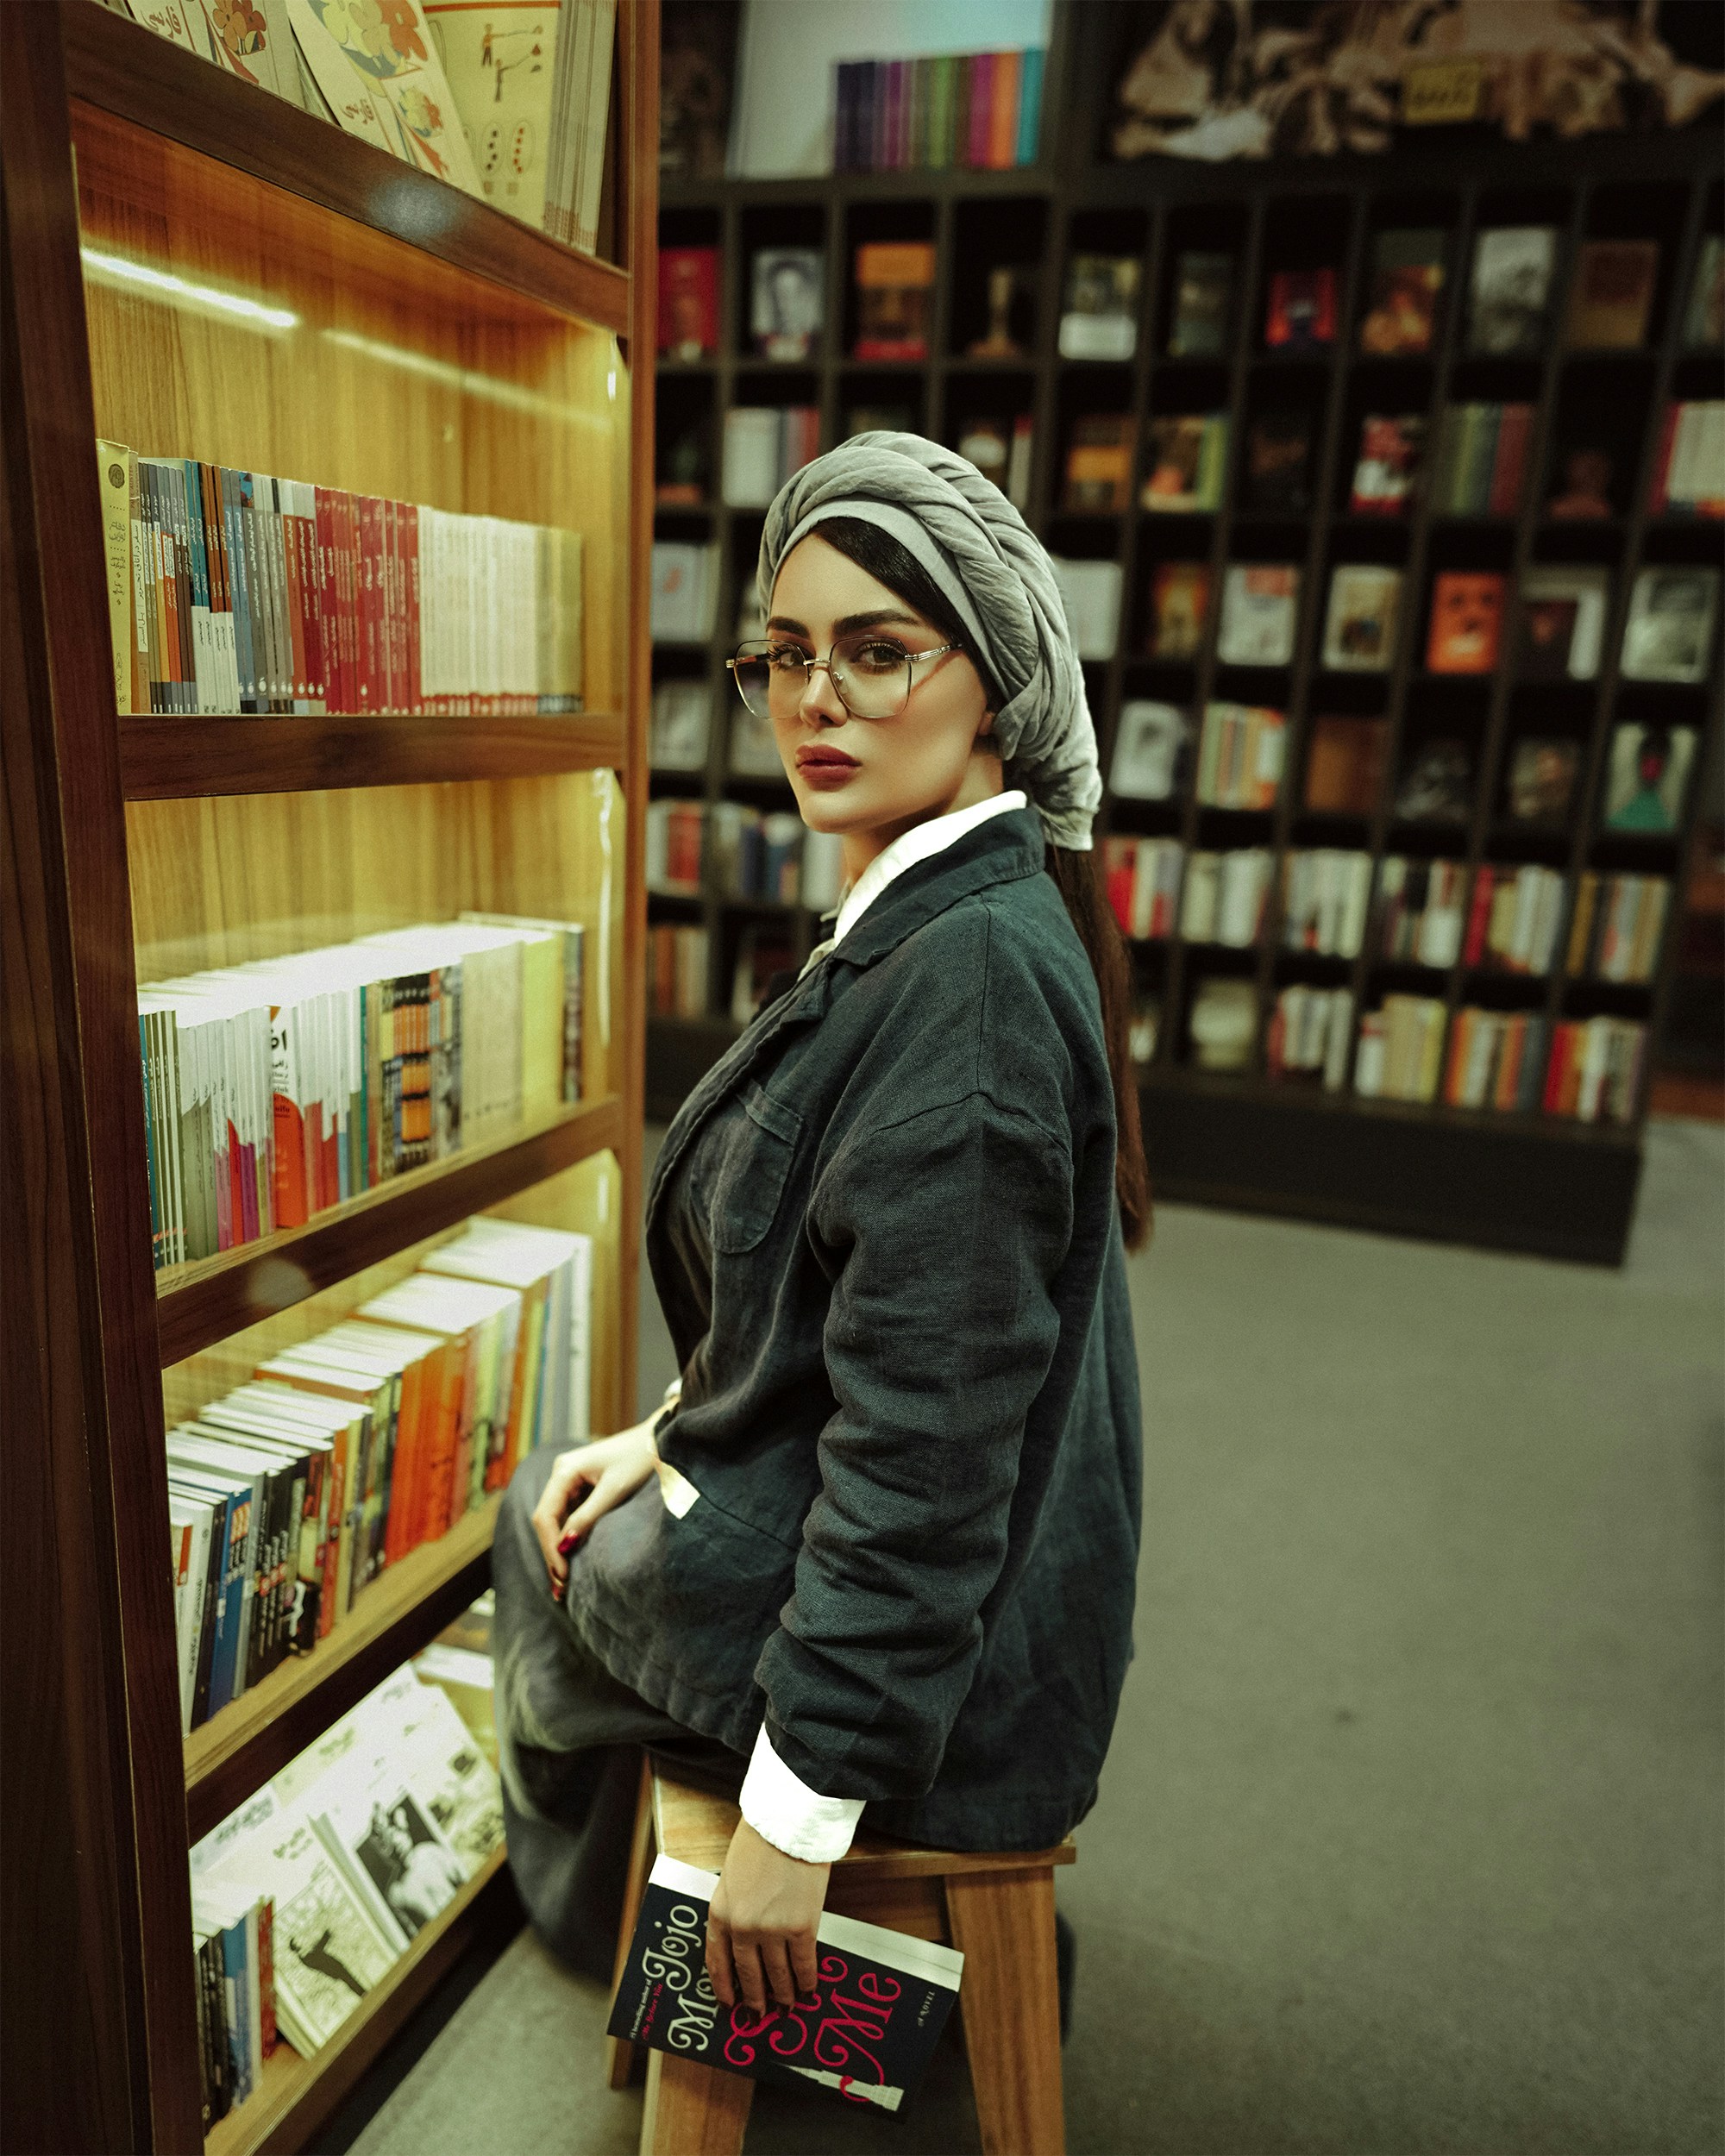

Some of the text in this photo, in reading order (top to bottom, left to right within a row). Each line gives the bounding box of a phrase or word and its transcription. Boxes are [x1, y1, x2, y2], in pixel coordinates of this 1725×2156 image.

[141, 5, 182, 39] فارسی
[339, 98, 375, 125] فارسی
[134, 555, 142, 572] اتاق
[642, 1904, 702, 1991] Jojo
[641, 1985, 650, 2005] author
[645, 1977, 653, 1986] of
[645, 1998, 658, 2023] Before
[653, 1983, 663, 1996] You
[813, 1972, 901, 2102] Me
